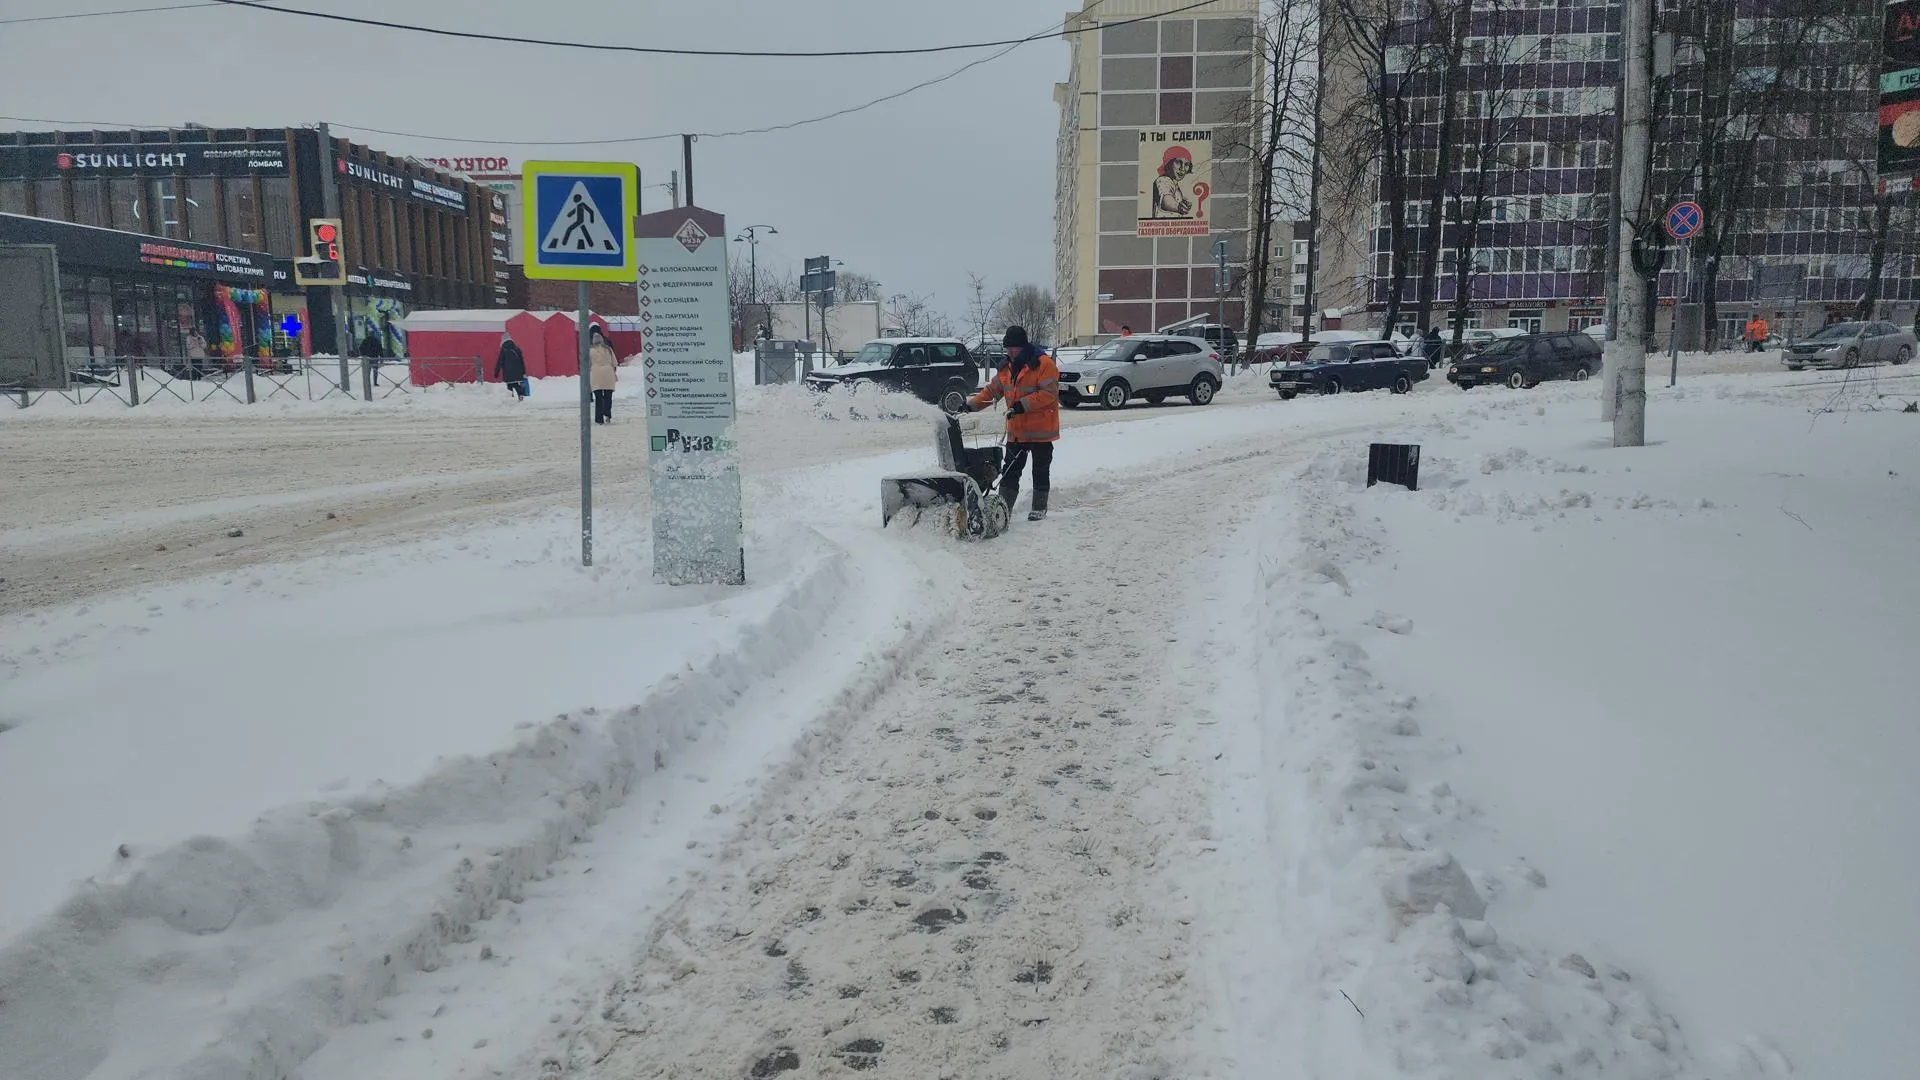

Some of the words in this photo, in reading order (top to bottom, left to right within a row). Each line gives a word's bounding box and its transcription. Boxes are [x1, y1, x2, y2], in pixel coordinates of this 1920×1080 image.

[1140, 132, 1147, 142] А
[1150, 131, 1166, 142] ТЫ
[1172, 130, 1211, 142] СДЕЛАЛ
[76, 153, 187, 168] SUNLIGHT
[248, 160, 284, 168] ЛОМБАРД
[454, 157, 508, 172] ХУТОР
[347, 162, 404, 189] SUNLIGHT
[1138, 227, 1165, 236] ГАЗОВОГО
[1166, 226, 1209, 236] ОБОРУДОВАНИЯ
[328, 241, 338, 260] 6
[216, 253, 251, 265] КОСМЕТИКА
[216, 263, 244, 273] БЫТОВАЯ
[244, 267, 264, 277] ХИМИЯ
[274, 270, 286, 279] RU
[667, 428, 714, 454] Руза
